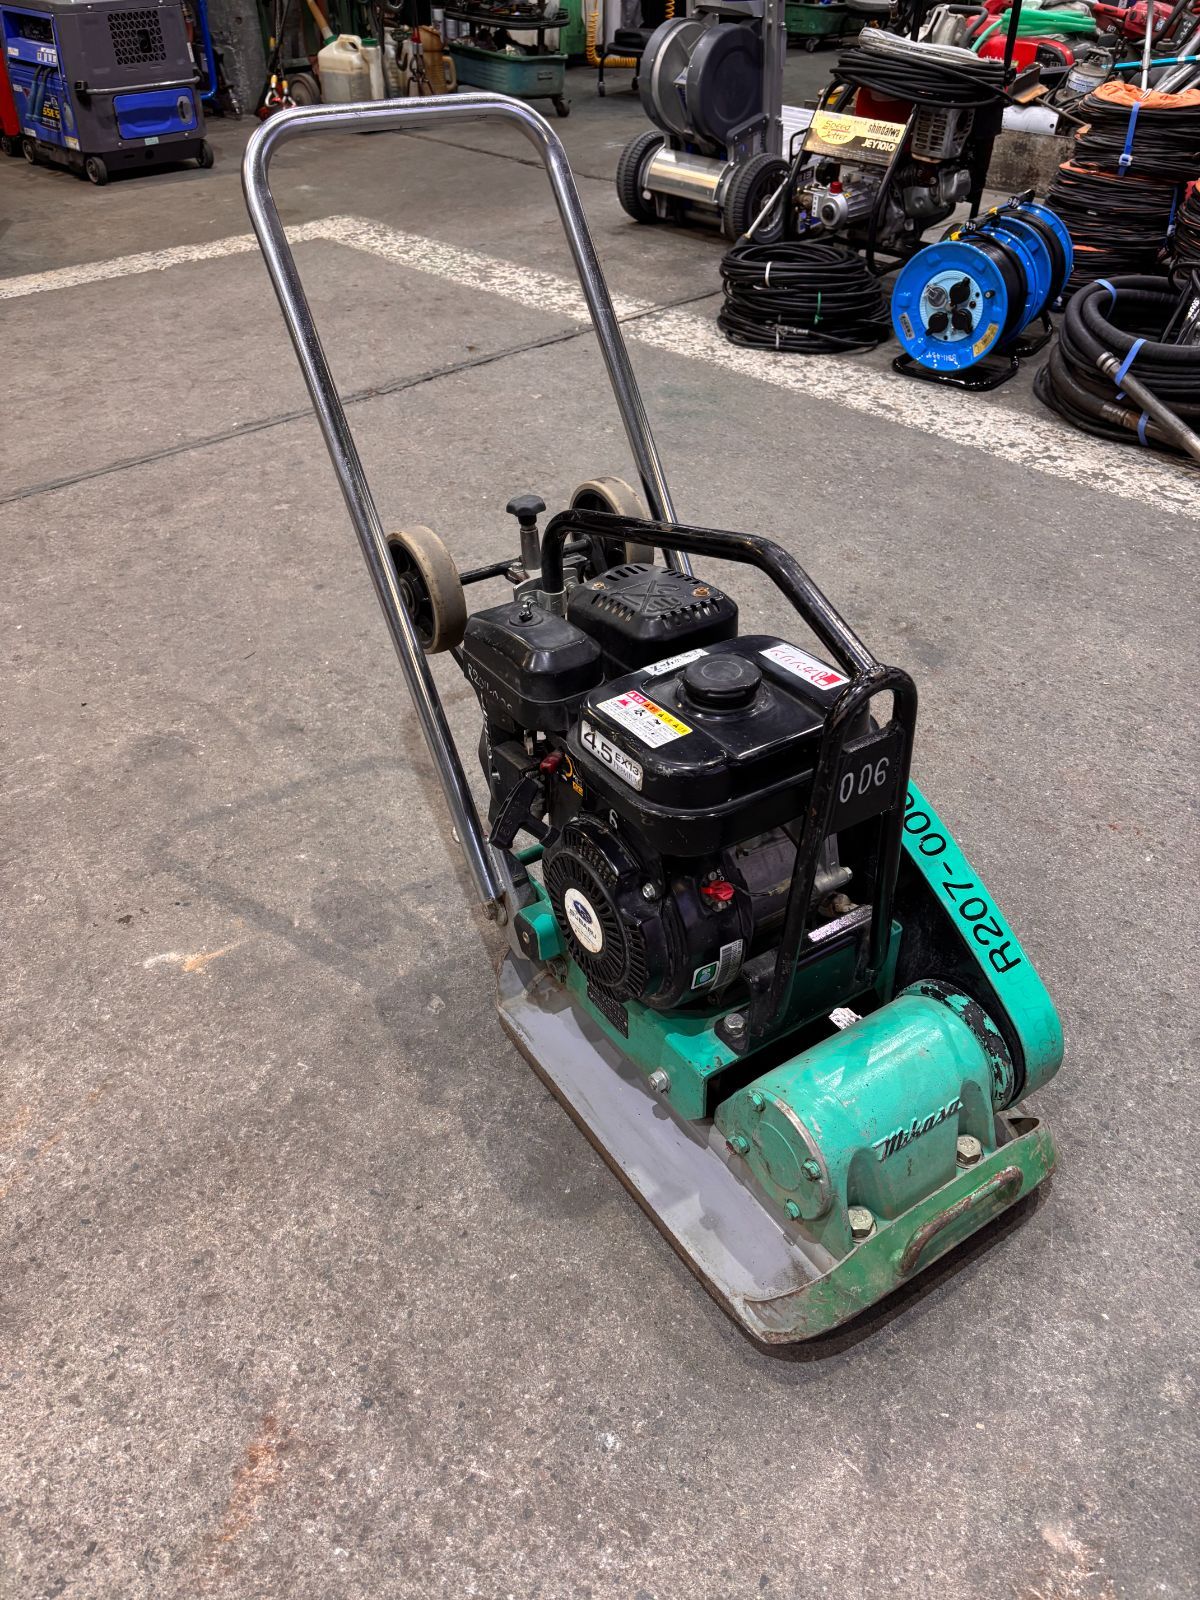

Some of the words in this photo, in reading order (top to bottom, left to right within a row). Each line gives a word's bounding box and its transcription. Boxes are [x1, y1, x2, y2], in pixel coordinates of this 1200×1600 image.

[823, 120, 851, 130] Speed
[867, 123, 901, 138] shindaiwa
[861, 138, 896, 151] JEY1010
[583, 731, 613, 764] 4.5
[614, 752, 639, 776] EX13
[840, 757, 889, 803] 006
[872, 1096, 963, 1163] Mikasa
